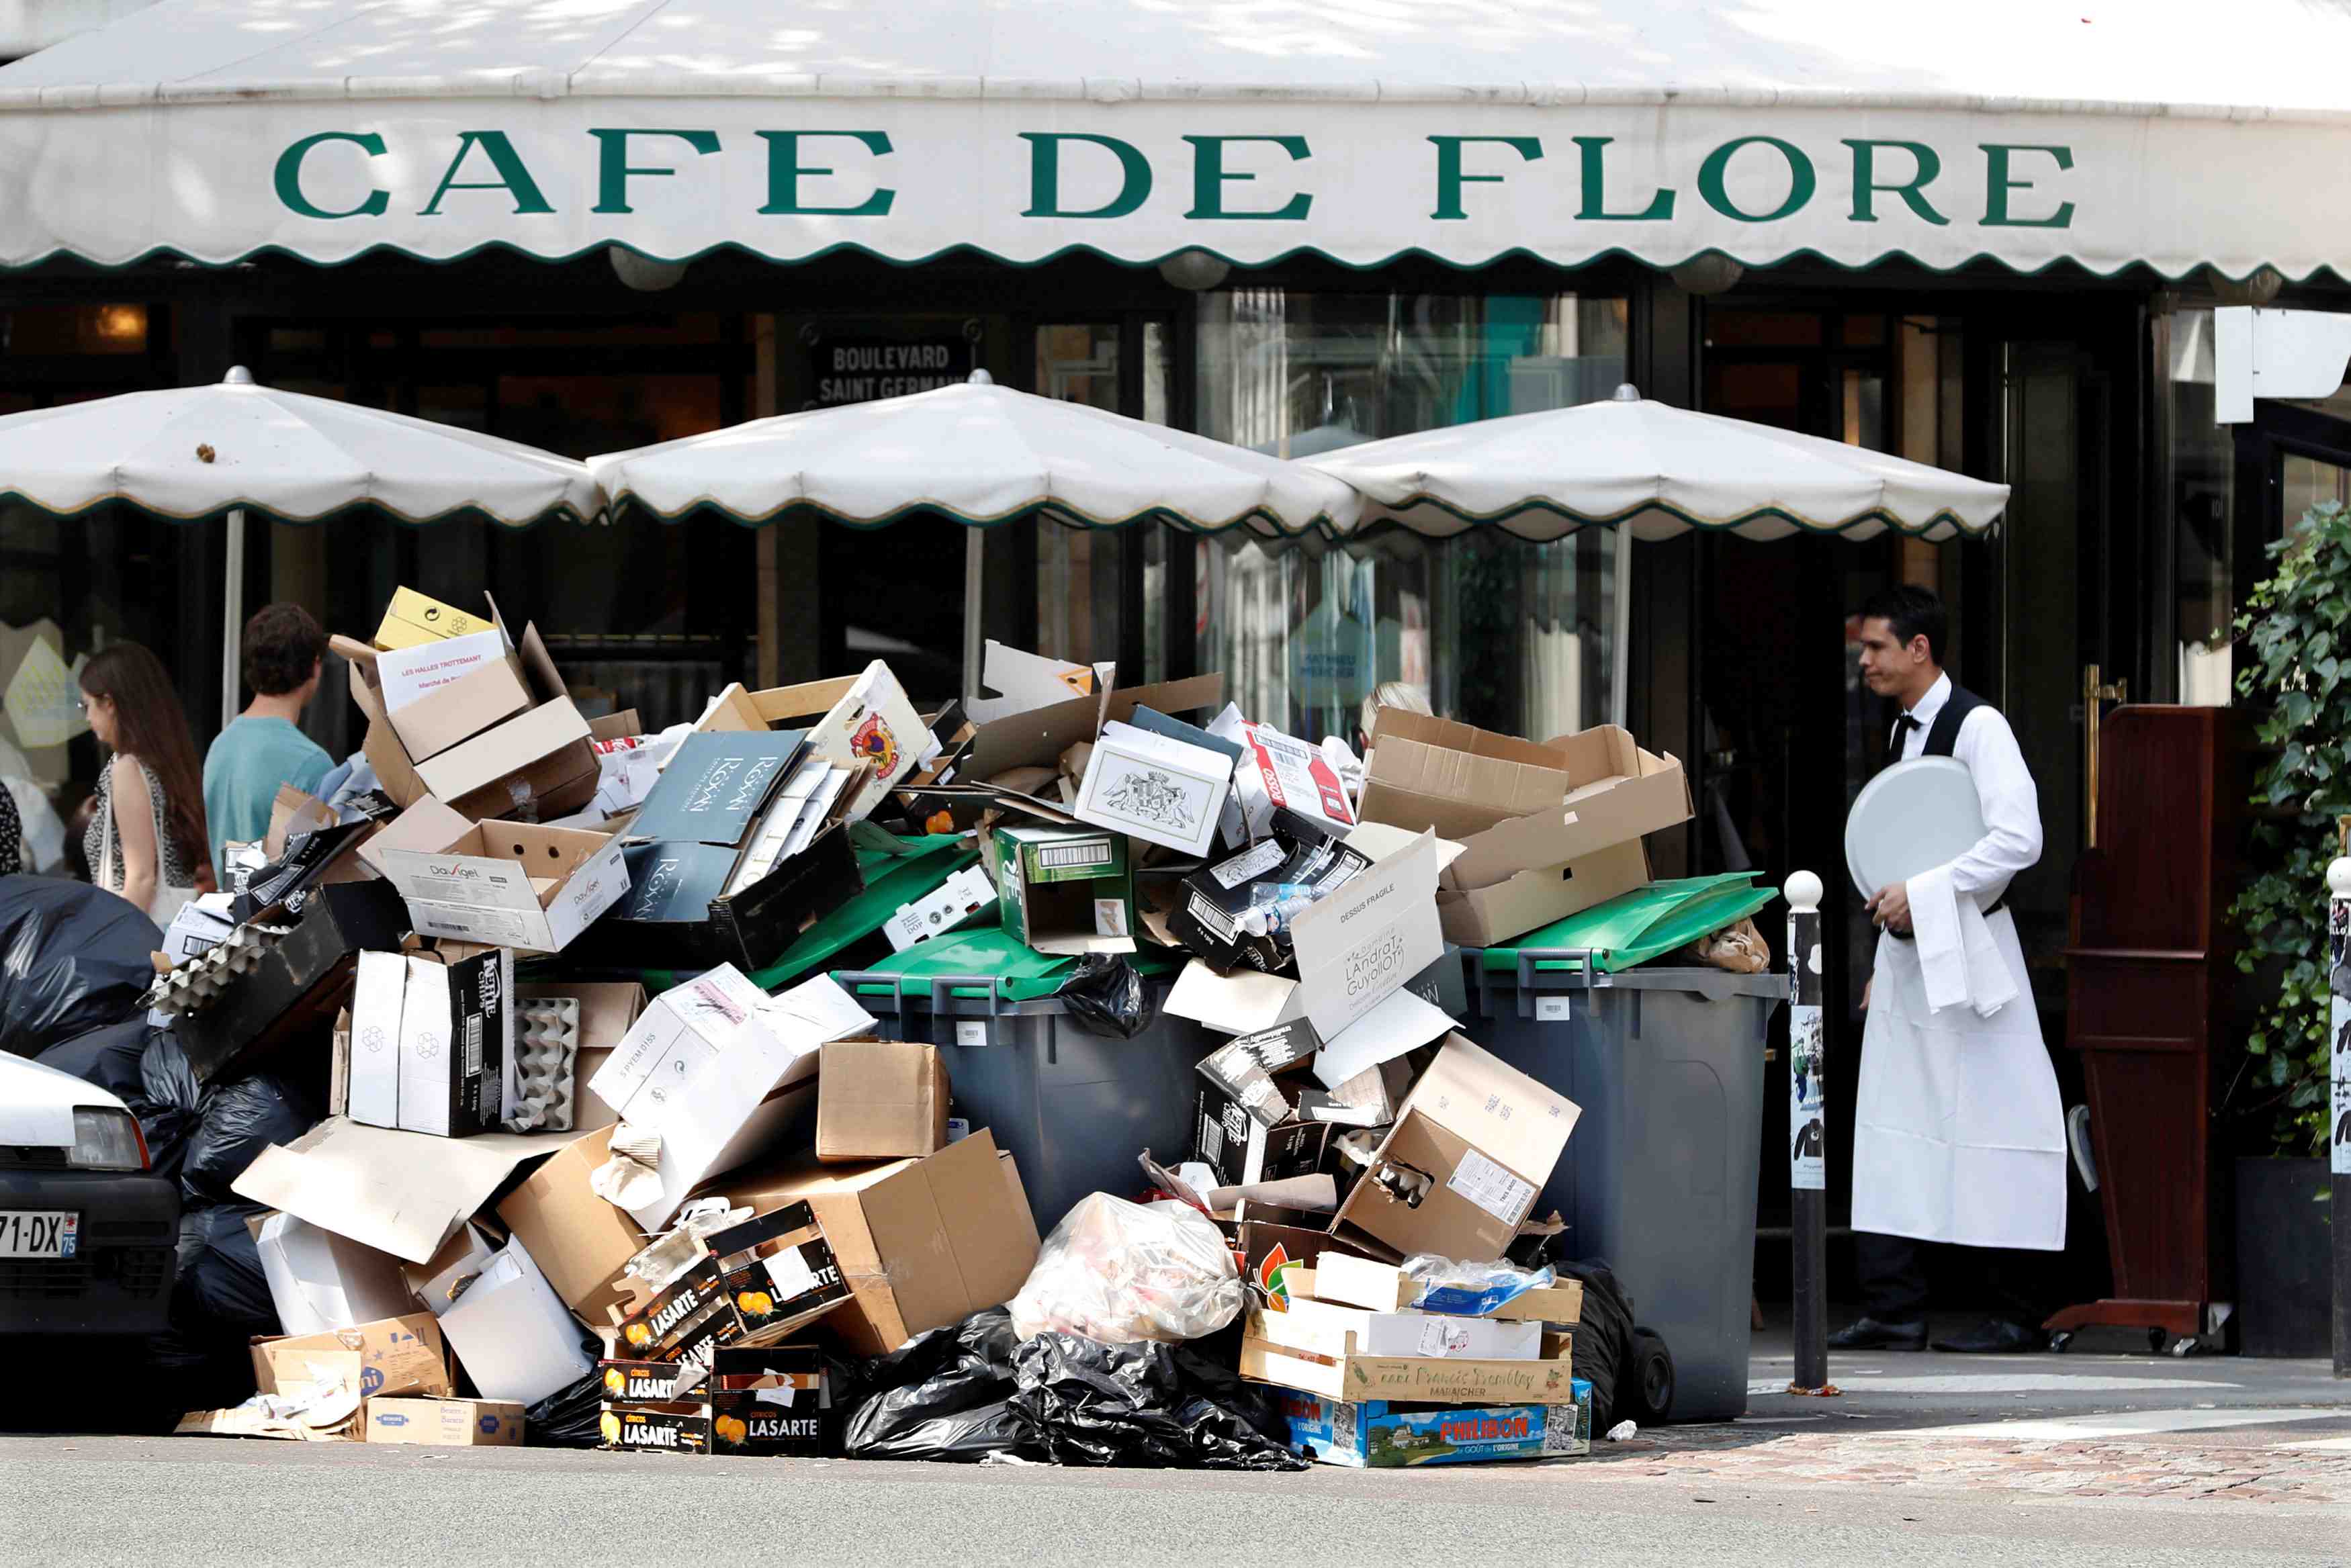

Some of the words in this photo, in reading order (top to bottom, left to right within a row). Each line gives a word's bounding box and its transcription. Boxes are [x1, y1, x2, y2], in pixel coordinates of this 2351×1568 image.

[273, 128, 896, 220] CAFE
[1017, 131, 1313, 220] DE
[1425, 134, 2076, 228] FLORE
[833, 344, 949, 371] BOULEVARD
[819, 377, 875, 402] SAINT
[880, 375, 965, 399] GERM
[414, 663, 439, 674] HALLES
[1263, 768, 1284, 802] ROSSO
[429, 862, 479, 880] Davigel
[1339, 901, 1366, 924] DESSUS
[1366, 882, 1396, 907] FRAGILE
[62, 1236, 76, 1254] 75
[769, 1264, 840, 1303] LRTE
[650, 1288, 699, 1337] LASARTE
[629, 1378, 676, 1399] LASART
[624, 1424, 678, 1447] LASARTE
[749, 1418, 817, 1437] LASARTE
[1439, 1417, 1529, 1442] PHILIBON
[1492, 1443, 1520, 1453] L'ORIGINE
